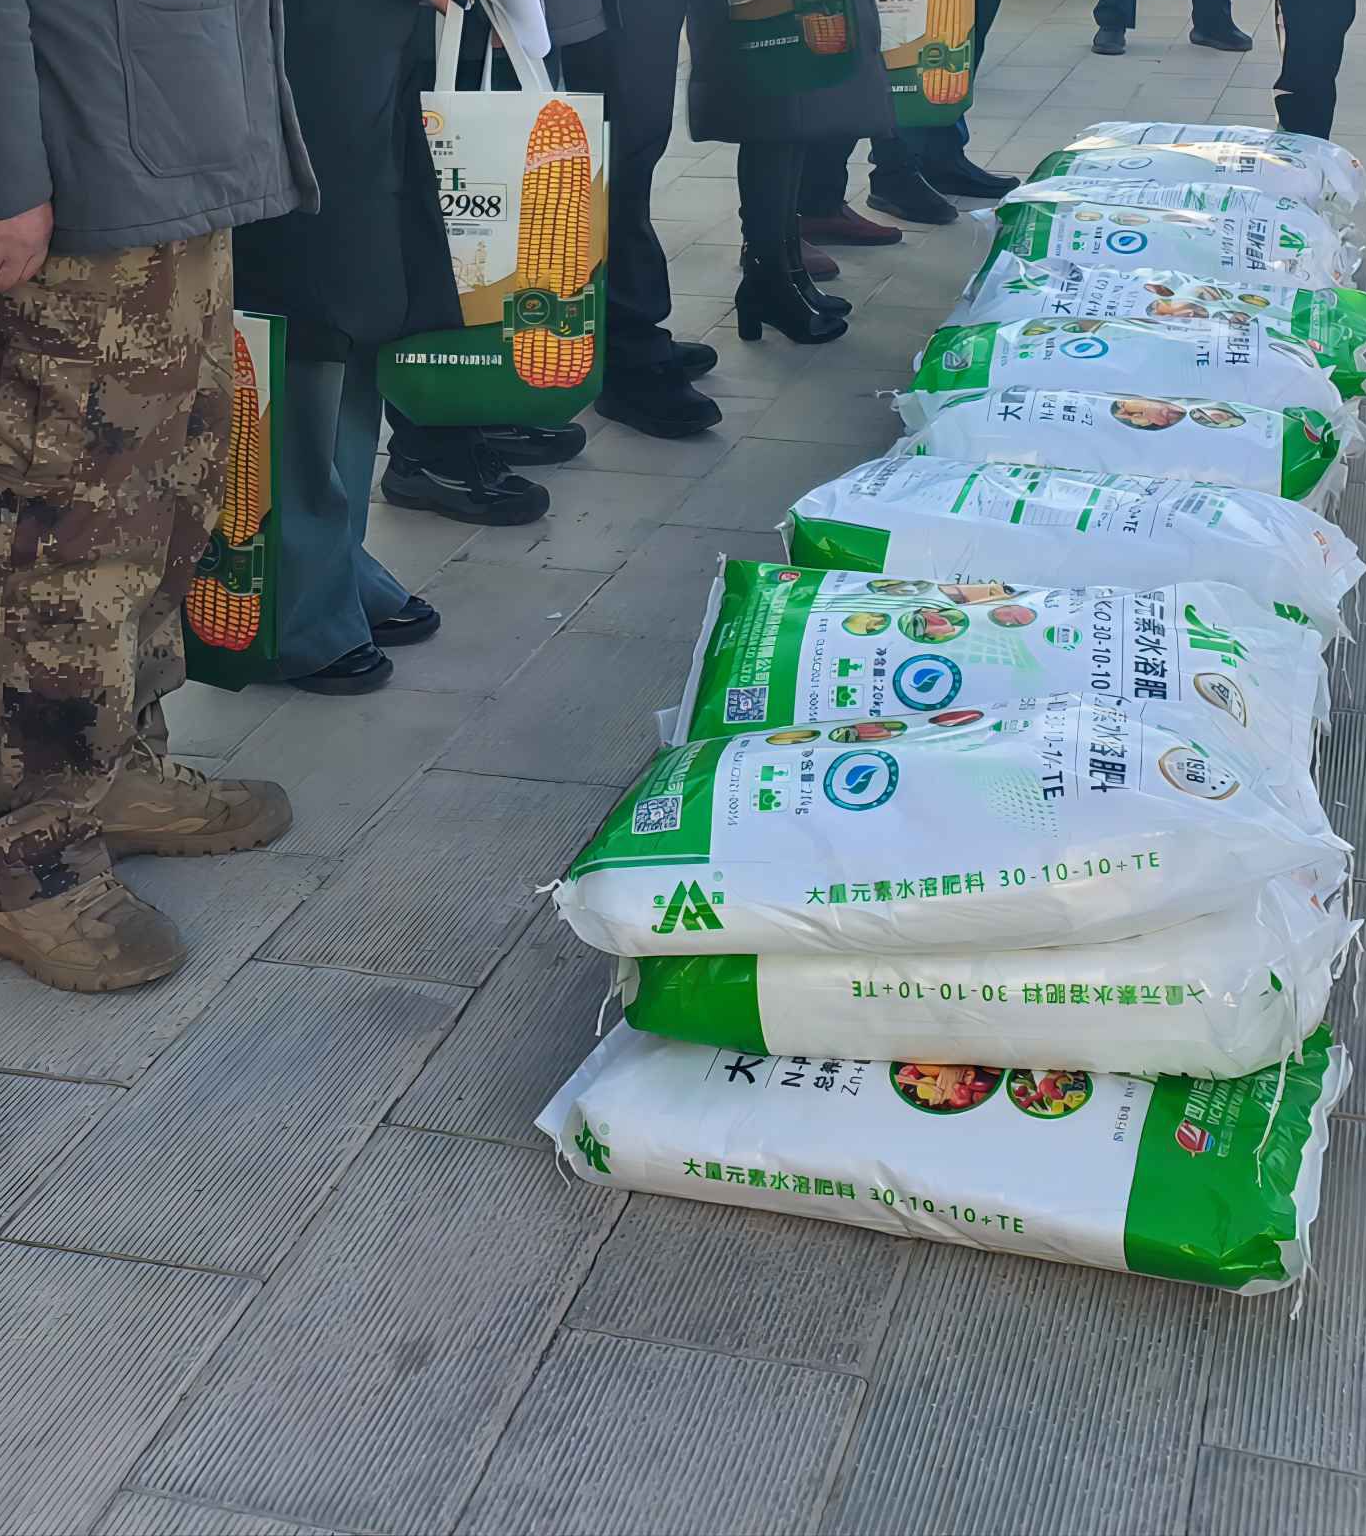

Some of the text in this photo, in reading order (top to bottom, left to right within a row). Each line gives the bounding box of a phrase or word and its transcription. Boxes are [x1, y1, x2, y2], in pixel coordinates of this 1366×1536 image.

[438, 194, 502, 218] 2988
[804, 851, 1161, 905] 大量元素水溶肥料 30-10-10+TE
[851, 979, 1009, 1003] 30-10-10+TE
[682, 1157, 1025, 1235] 大量元素水溶肥料 30-10-10+TE
